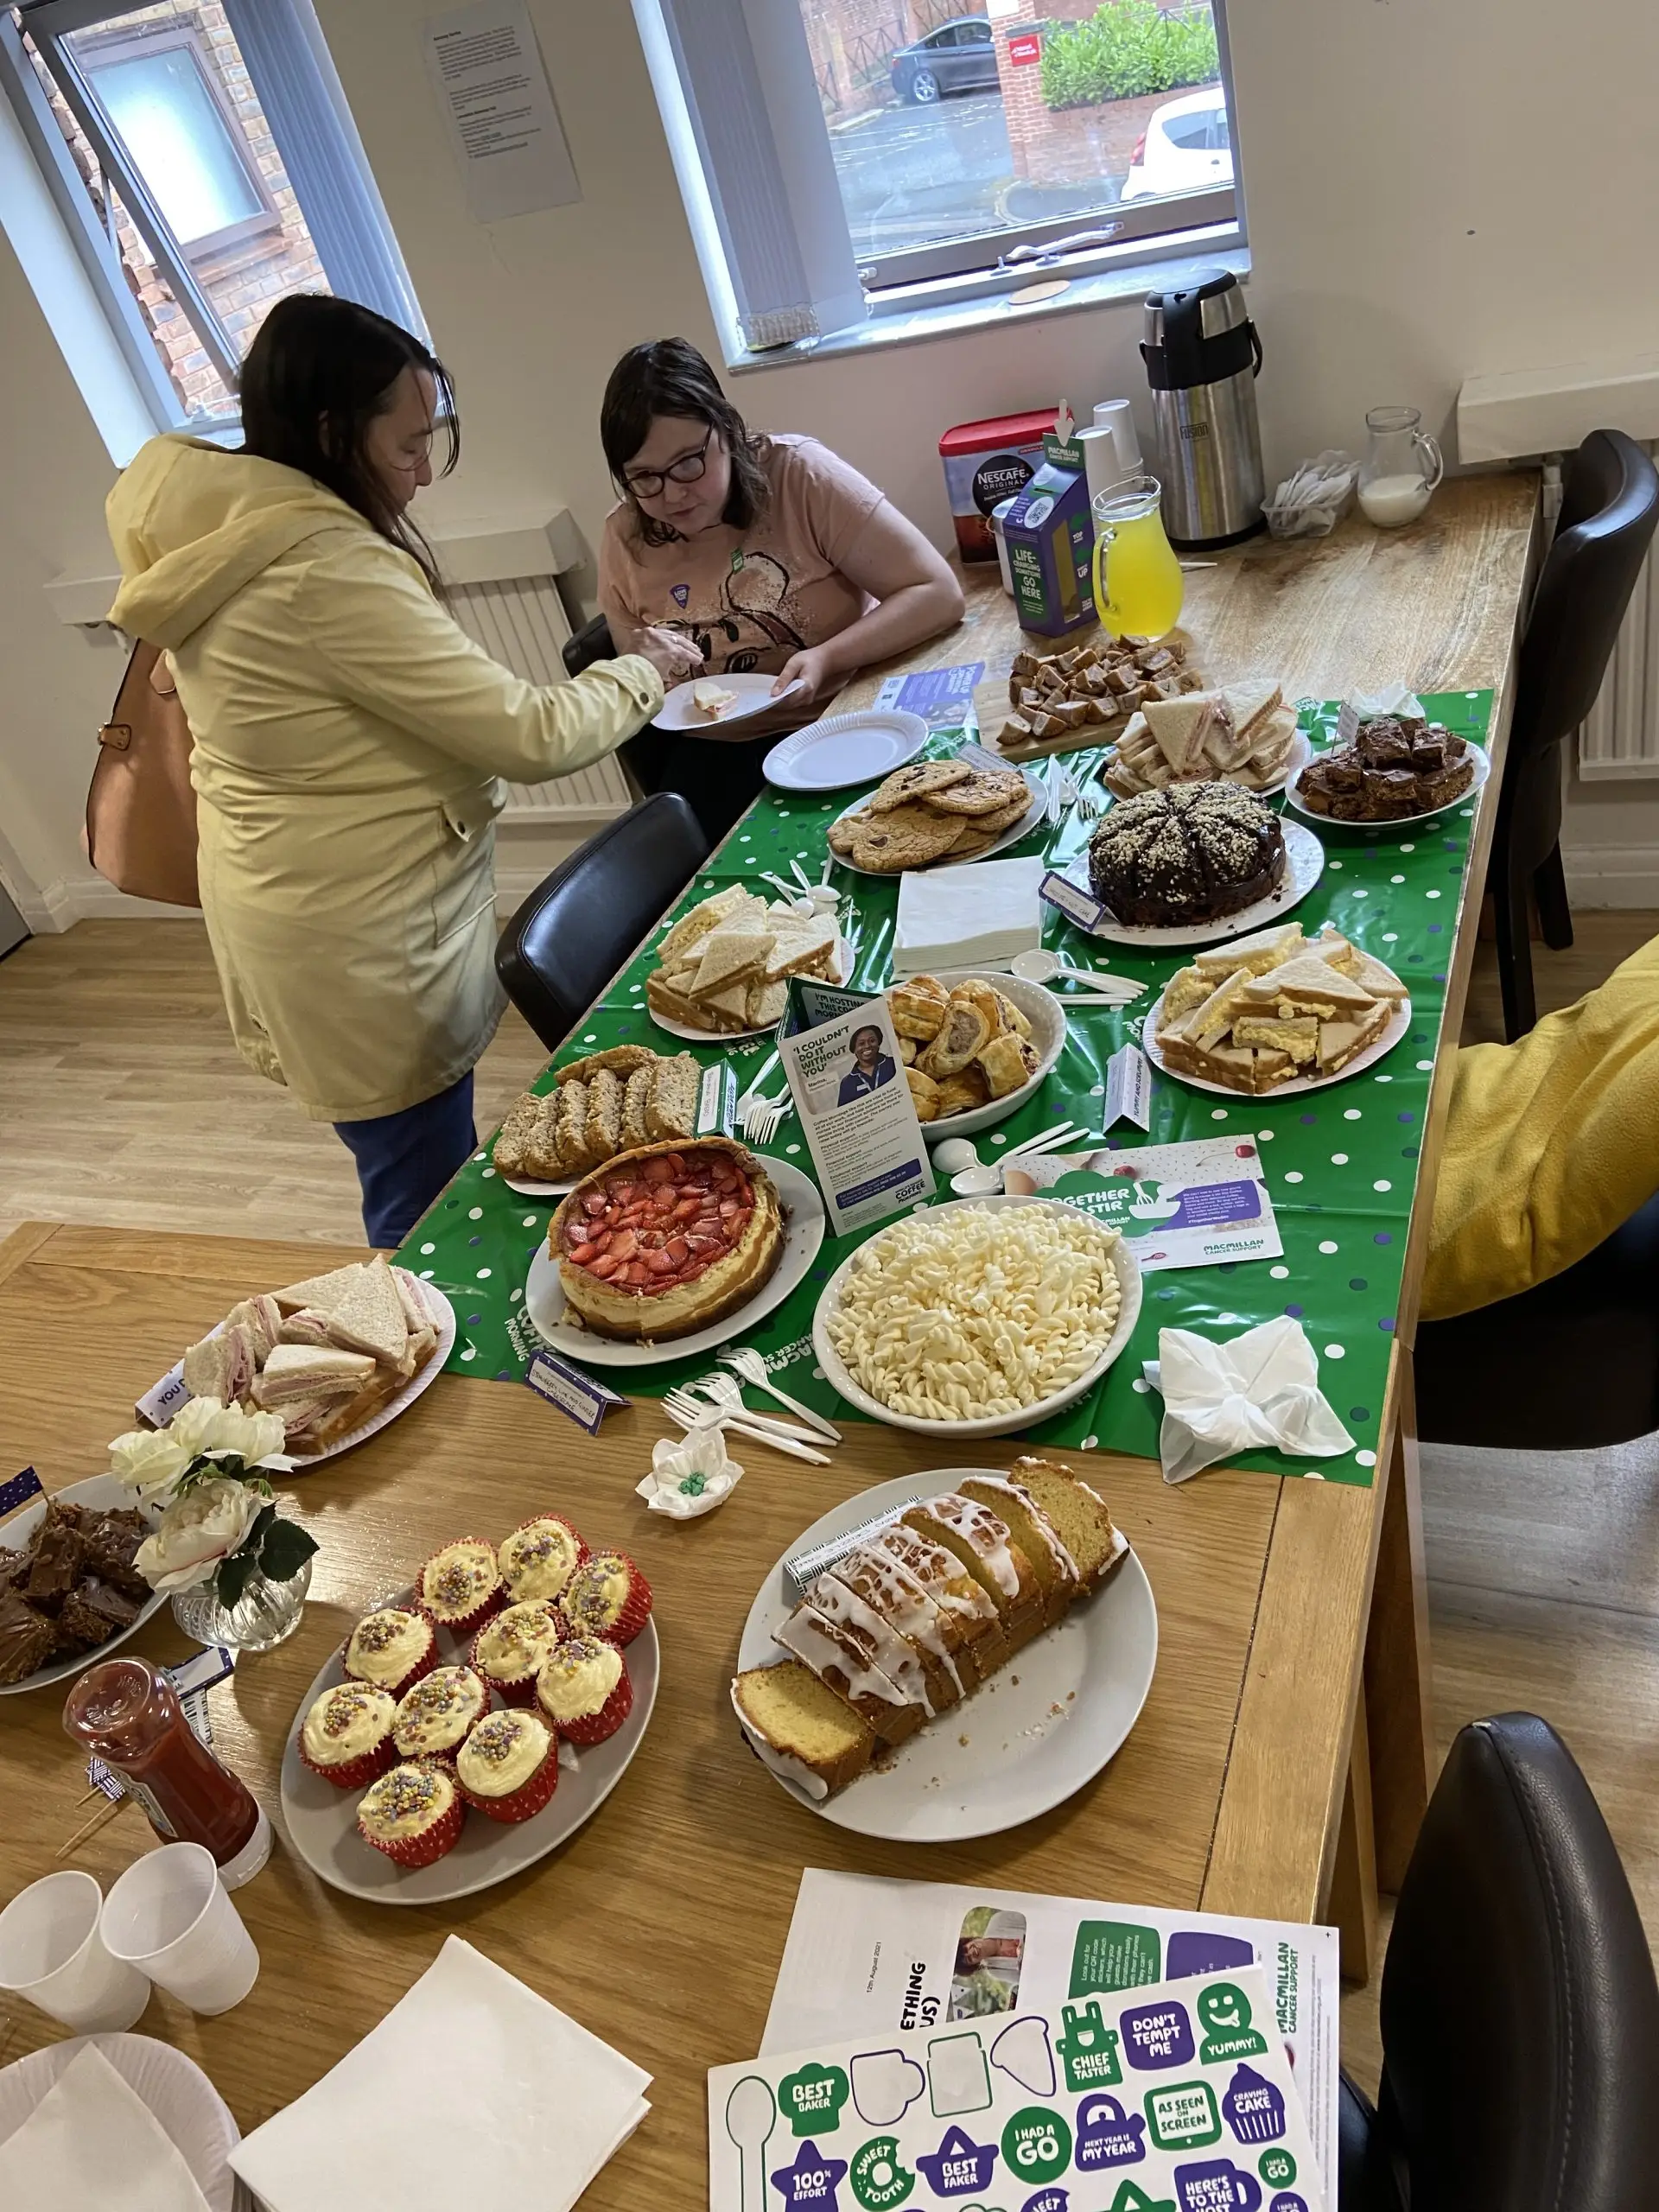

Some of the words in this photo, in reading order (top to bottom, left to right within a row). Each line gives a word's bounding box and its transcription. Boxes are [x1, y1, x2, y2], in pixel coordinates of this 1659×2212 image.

[983, 479, 1024, 490] ORIGINAL
[1014, 550, 1036, 563] LIFE-
[1023, 576, 1035, 587] GO
[1077, 568, 1088, 578] UP
[1021, 586, 1041, 599] HERE
[802, 1026, 849, 1052] COULDN'T
[799, 1051, 815, 1062] DO
[815, 1046, 824, 1056] IT
[801, 1045, 847, 1070] WITHOUT
[895, 1180, 925, 1199] COFFEE
[1049, 1189, 1130, 1207] GETHER
[1086, 1200, 1123, 1215] STIR
[1204, 1239, 1264, 1251] MACMILLAN
[1233, 1244, 1262, 1253] SUPPORT
[505, 1317, 530, 1362] MORNING
[775, 1333, 813, 1357] ANCER
[157, 1384, 180, 1405] YOU
[869, 1957, 879, 1979] August
[1289, 1948, 1299, 1994] SUPPORT
[900, 1962, 926, 2031] ETHING
[1276, 1942, 1289, 2033] MACMILLAN
[919, 1996, 941, 2028] US)
[1288, 1994, 1297, 2034] CANCER
[1133, 2013, 1176, 2031] DON'T
[1133, 2026, 1180, 2046] TEMPT
[1149, 2041, 1172, 2057] ME
[1207, 2037, 1257, 2056] YUMMY!
[1071, 2052, 1109, 2072] CHIEF
[1074, 2064, 1112, 2082] TASTER
[792, 2078, 835, 2102] BEST
[1233, 2088, 1268, 2101] CRAVING
[798, 2098, 831, 2113] BAKER
[1158, 2102, 1173, 2114] AS
[1175, 2094, 1204, 2111] SEEN
[1235, 2097, 1271, 2114] CAKE
[1014, 2129, 1020, 2140] I
[1021, 2126, 1046, 2139] HAD
[1046, 2124, 1055, 2135] A
[1160, 2113, 1207, 2133] SCREEN
[1084, 2139, 1102, 2148] NEXT
[1103, 2136, 1122, 2145] YEAR
[1122, 2133, 1130, 2142] IS
[1016, 2136, 1059, 2165] GO
[1082, 2146, 1102, 2162] MY
[1101, 2139, 1137, 2159] YEAR
[856, 2145, 891, 2176] SWEET
[942, 2158, 978, 2178] BEST
[792, 2169, 832, 2190] 100%
[1267, 2164, 1289, 2178] GO
[944, 2173, 979, 2189] FAKER
[1185, 2175, 1230, 2196] HERE'S
[793, 2186, 828, 2202] EFFORT
[864, 2179, 905, 2203] TOOTH
[1186, 2196, 1207, 2209] TO
[1208, 2190, 1235, 2204] THE
